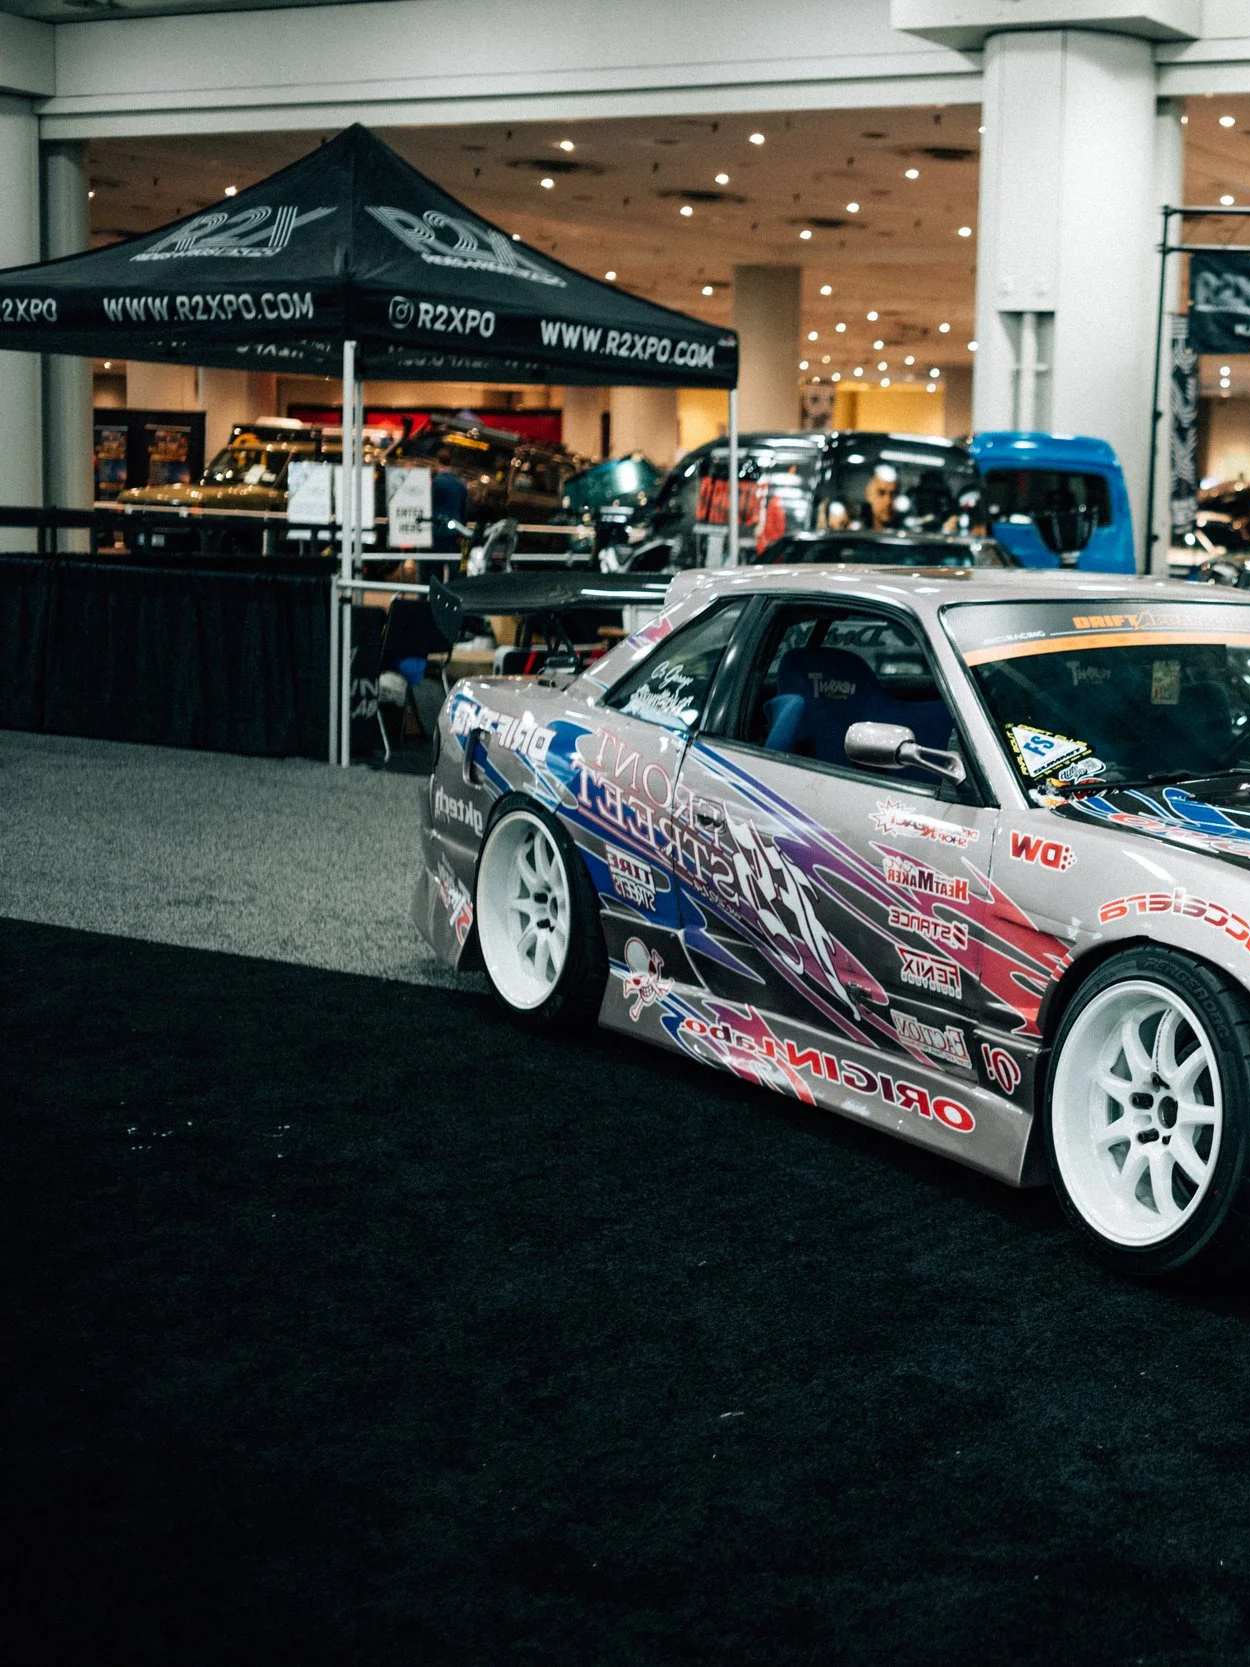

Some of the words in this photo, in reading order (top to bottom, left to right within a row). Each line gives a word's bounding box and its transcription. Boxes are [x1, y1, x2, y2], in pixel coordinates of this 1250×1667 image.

[0, 297, 57, 322] 2XPO
[102, 292, 314, 322] WWW.R2XPO.COM
[417, 301, 496, 338] R2XPO
[540, 319, 716, 369] WWW.R2XPO.COM
[1072, 615, 1139, 631] DRIFT
[1022, 735, 1055, 757] FS
